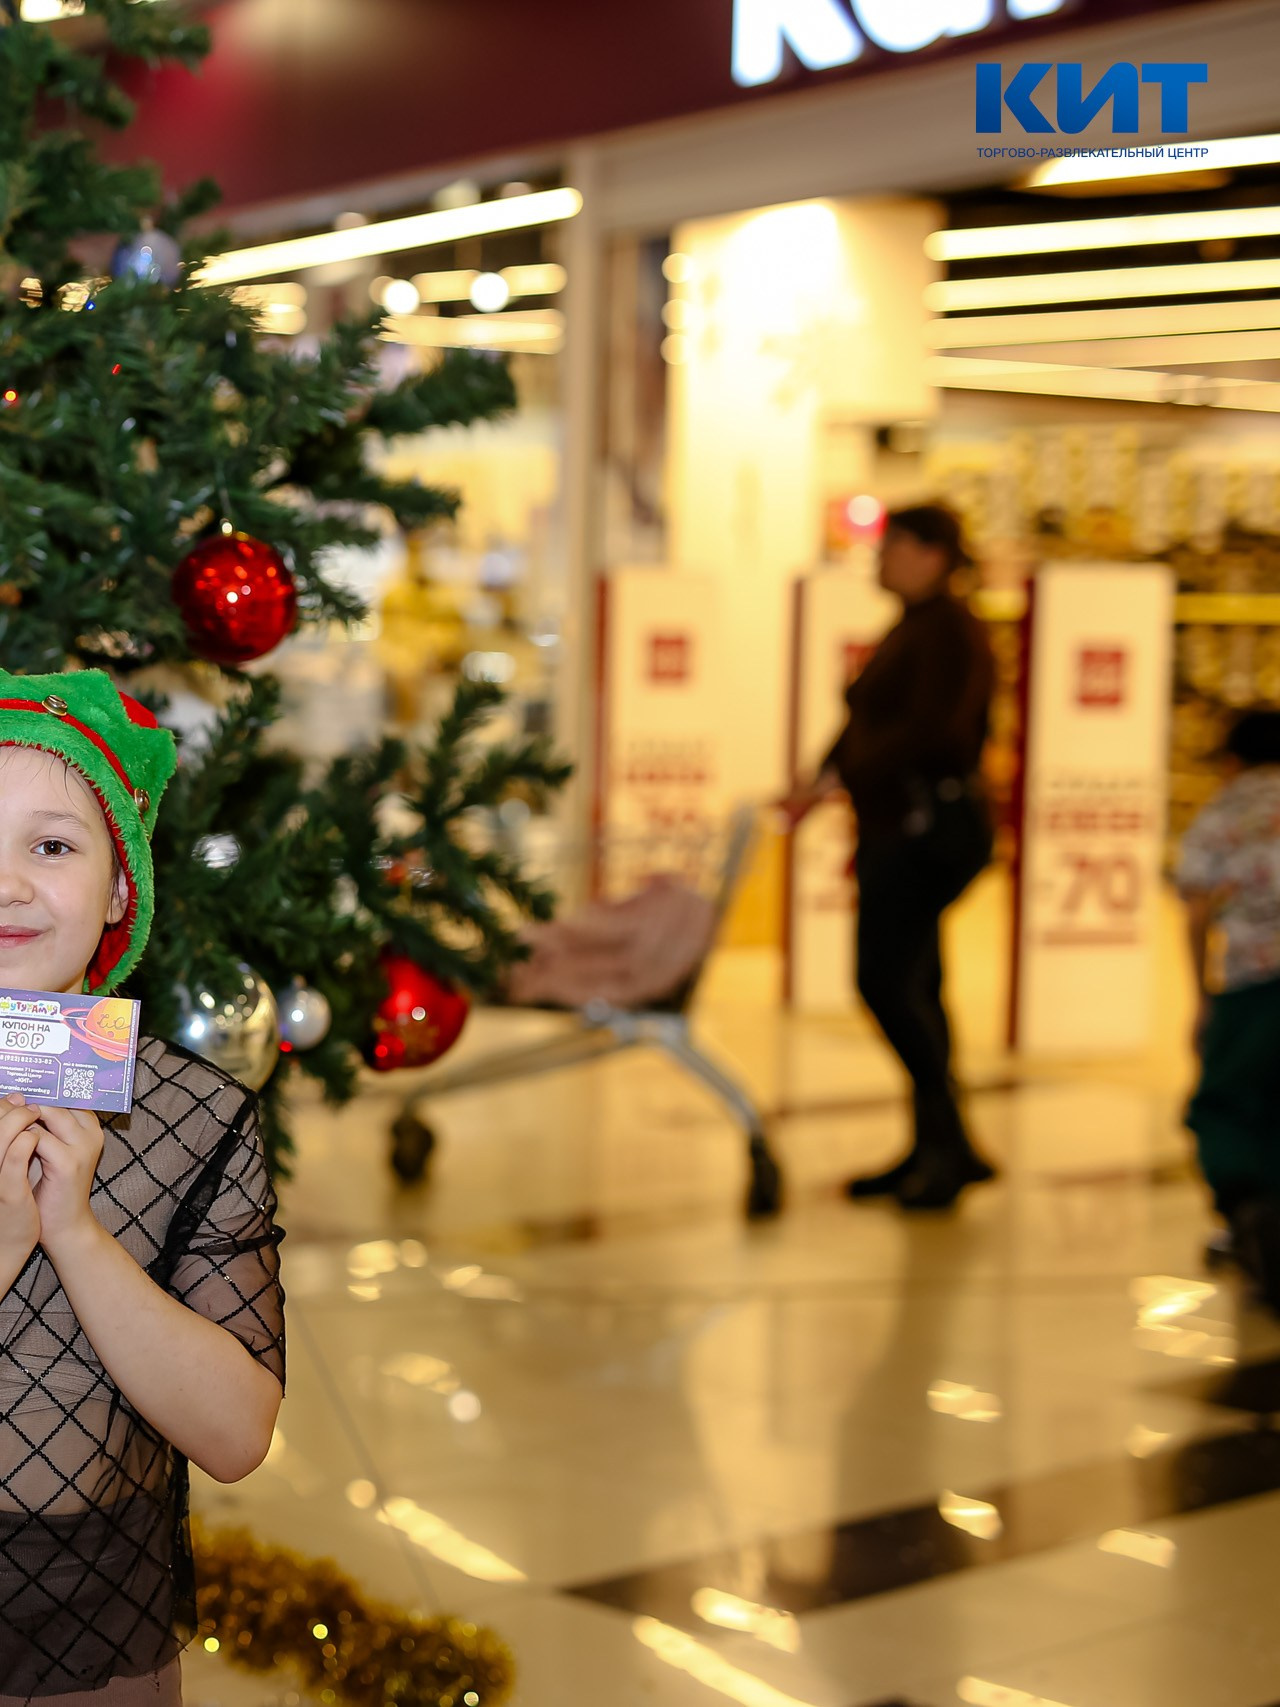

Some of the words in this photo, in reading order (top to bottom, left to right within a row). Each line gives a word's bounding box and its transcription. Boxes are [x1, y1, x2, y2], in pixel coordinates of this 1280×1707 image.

[2, 1021, 35, 1031] КУПОН
[37, 1024, 51, 1032] НА
[5, 1031, 29, 1048] 50
